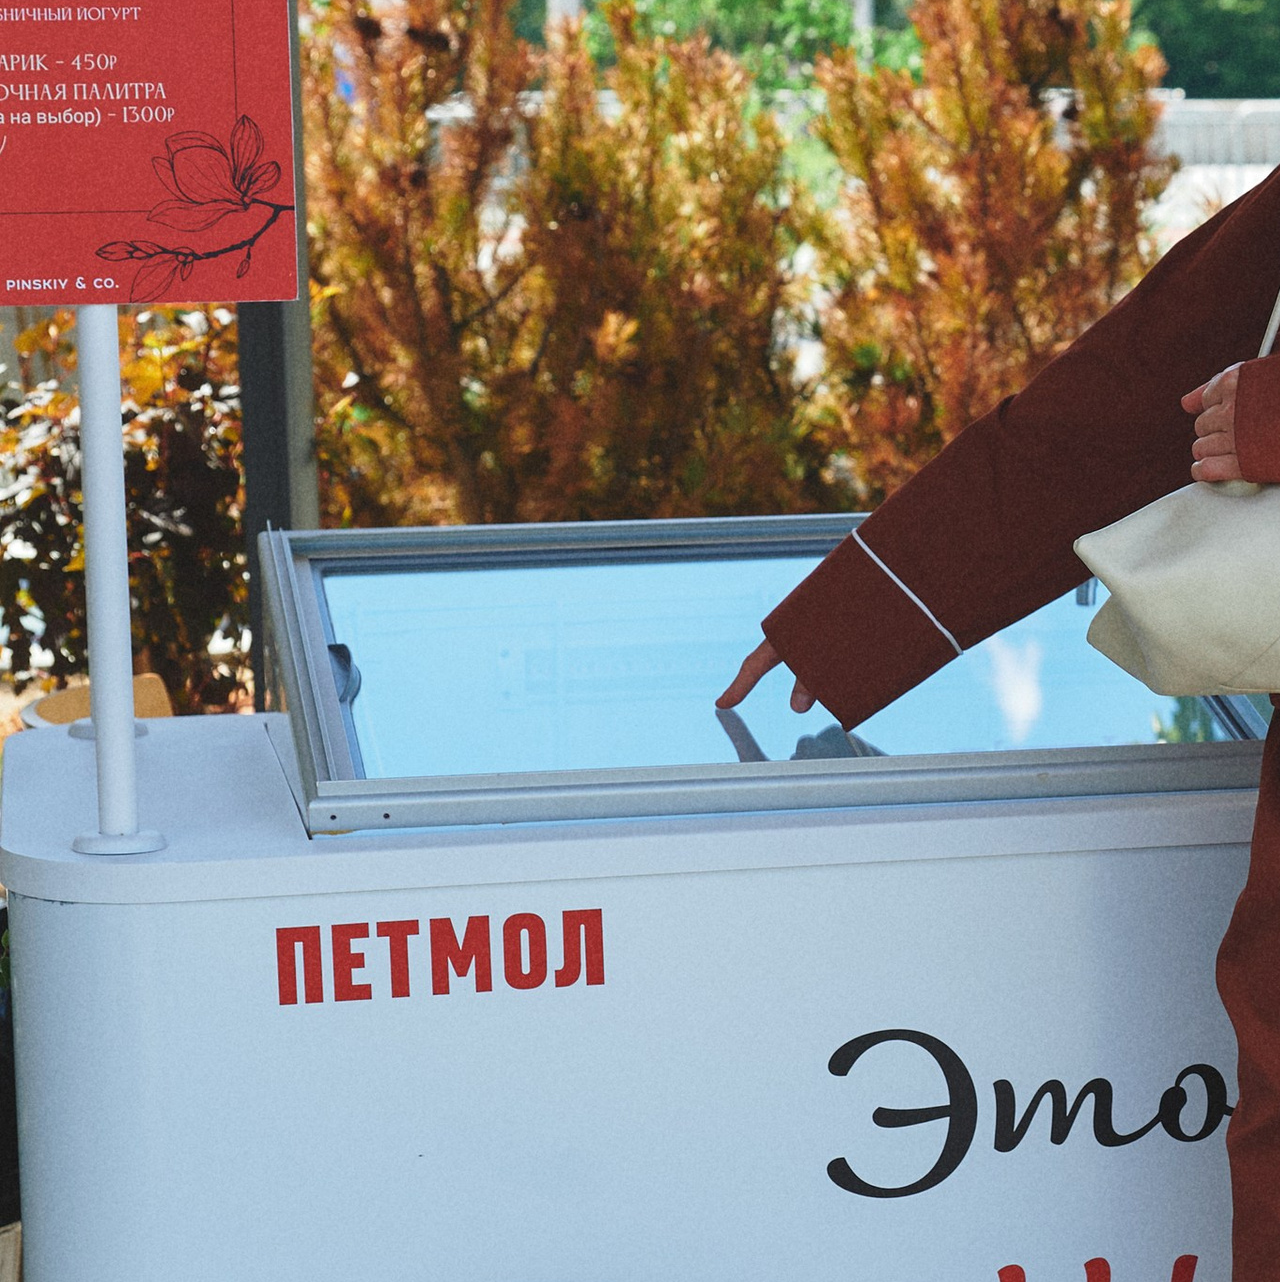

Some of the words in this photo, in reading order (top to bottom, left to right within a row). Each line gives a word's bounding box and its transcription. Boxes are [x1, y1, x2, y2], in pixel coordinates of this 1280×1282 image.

[76, 6, 142, 21] ЙОГУРТ
[73, 82, 167, 101] ПАЛИТРА
[10, 111, 32, 125] на
[36, 106, 102, 128] выбор)
[6, 278, 69, 291] PINSKIY
[75, 276, 87, 290] &
[93, 277, 120, 289] CO.
[276, 909, 605, 1005] ПЕТМОЛ
[826, 1029, 1235, 1199] Это
